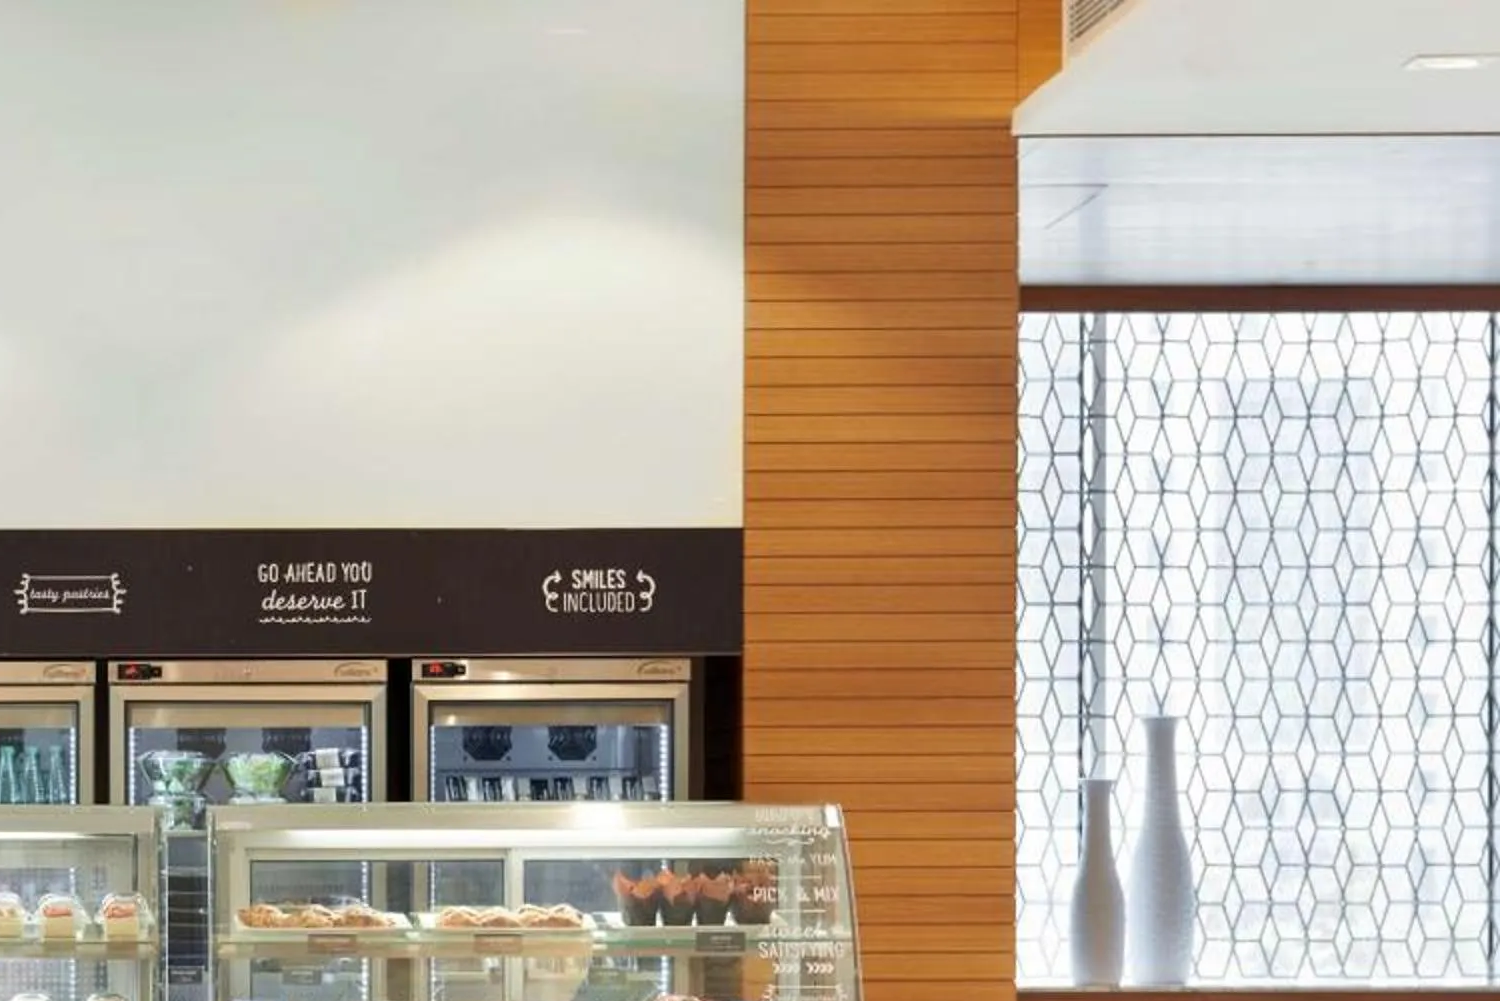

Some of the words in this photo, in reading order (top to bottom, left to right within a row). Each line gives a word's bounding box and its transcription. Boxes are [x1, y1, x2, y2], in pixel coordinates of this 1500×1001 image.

[257, 562, 279, 583] GO
[283, 561, 337, 583] AHEAD
[341, 560, 373, 583] YOU
[571, 569, 627, 589] SMILES
[29, 587, 60, 603] tasty
[61, 586, 110, 603] pastries
[261, 589, 347, 611] deserve
[351, 589, 368, 609] IT
[563, 592, 635, 613] INCLUDED
